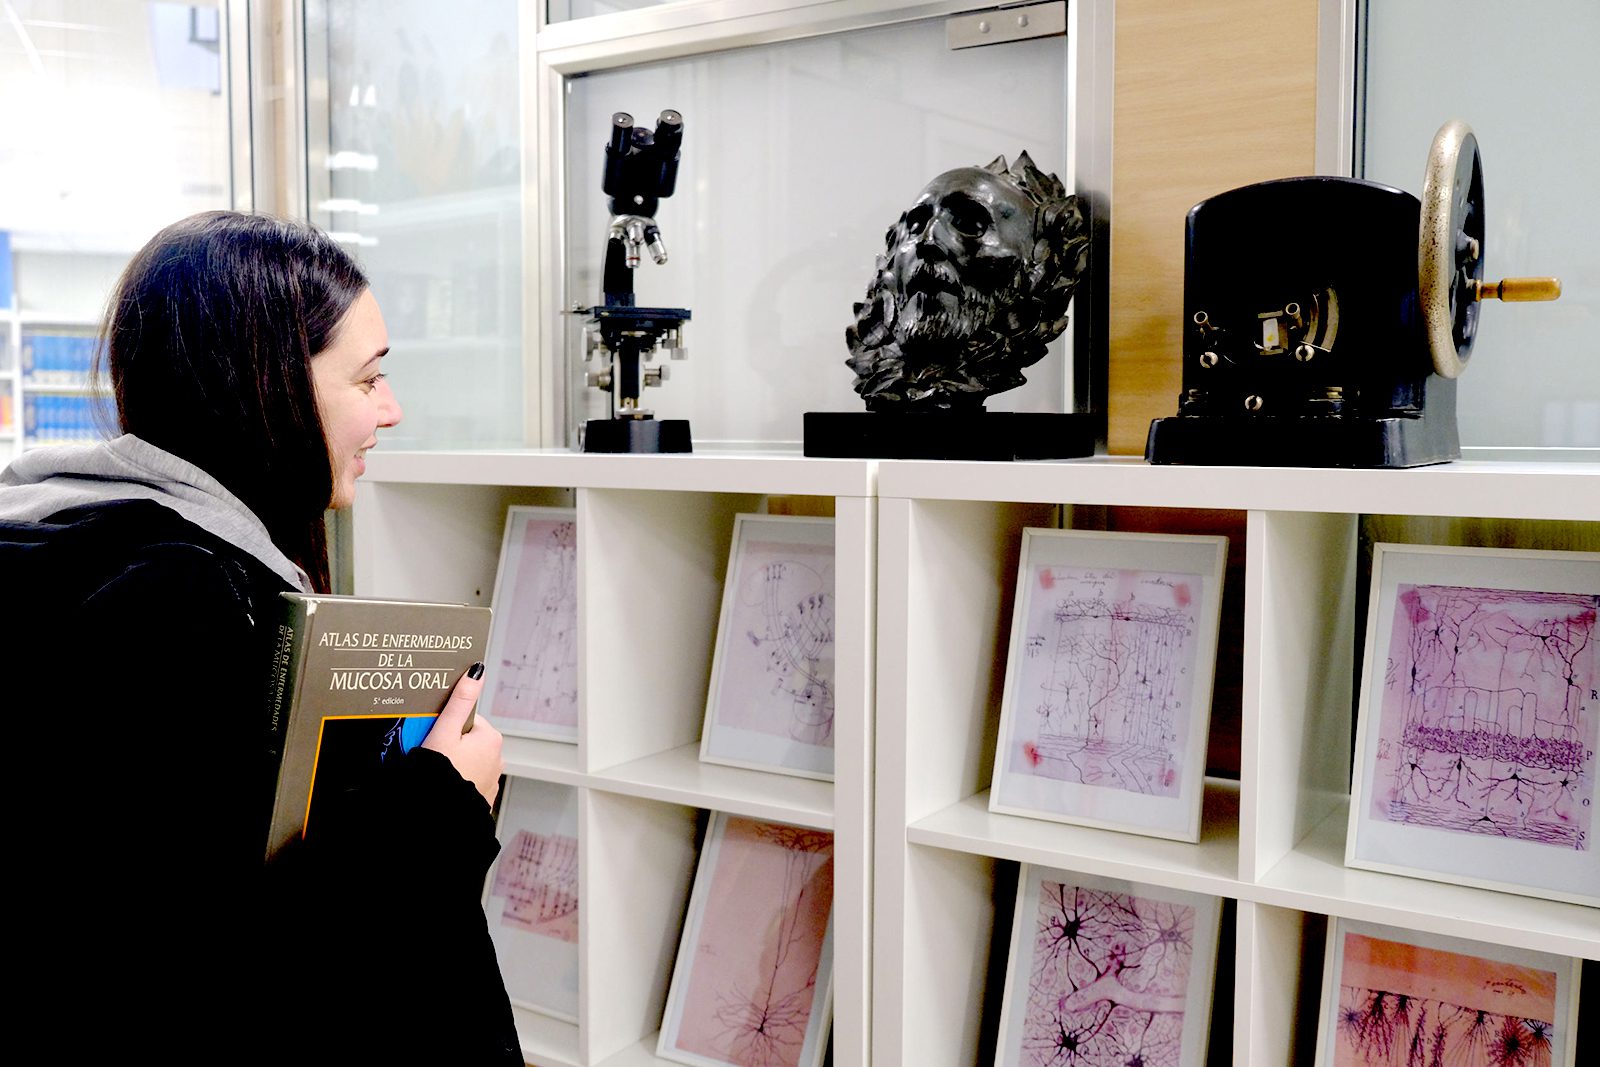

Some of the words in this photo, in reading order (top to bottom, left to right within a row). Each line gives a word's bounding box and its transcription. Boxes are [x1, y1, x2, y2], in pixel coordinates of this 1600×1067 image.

[283, 626, 294, 653] ATLAS
[318, 632, 360, 647] ATLAS
[362, 633, 379, 648] DE
[382, 633, 473, 650] ENFERMEDADES
[281, 654, 290, 666] DE
[378, 653, 395, 667] DE
[397, 653, 413, 668] LA
[329, 672, 403, 690] MUCOSA
[409, 672, 450, 690] ORAL
[1591, 689, 1598, 700] R
[382, 697, 405, 705] edición
[1586, 750, 1593, 761] P
[1582, 798, 1590, 807] O
[1578, 831, 1585, 841] S
